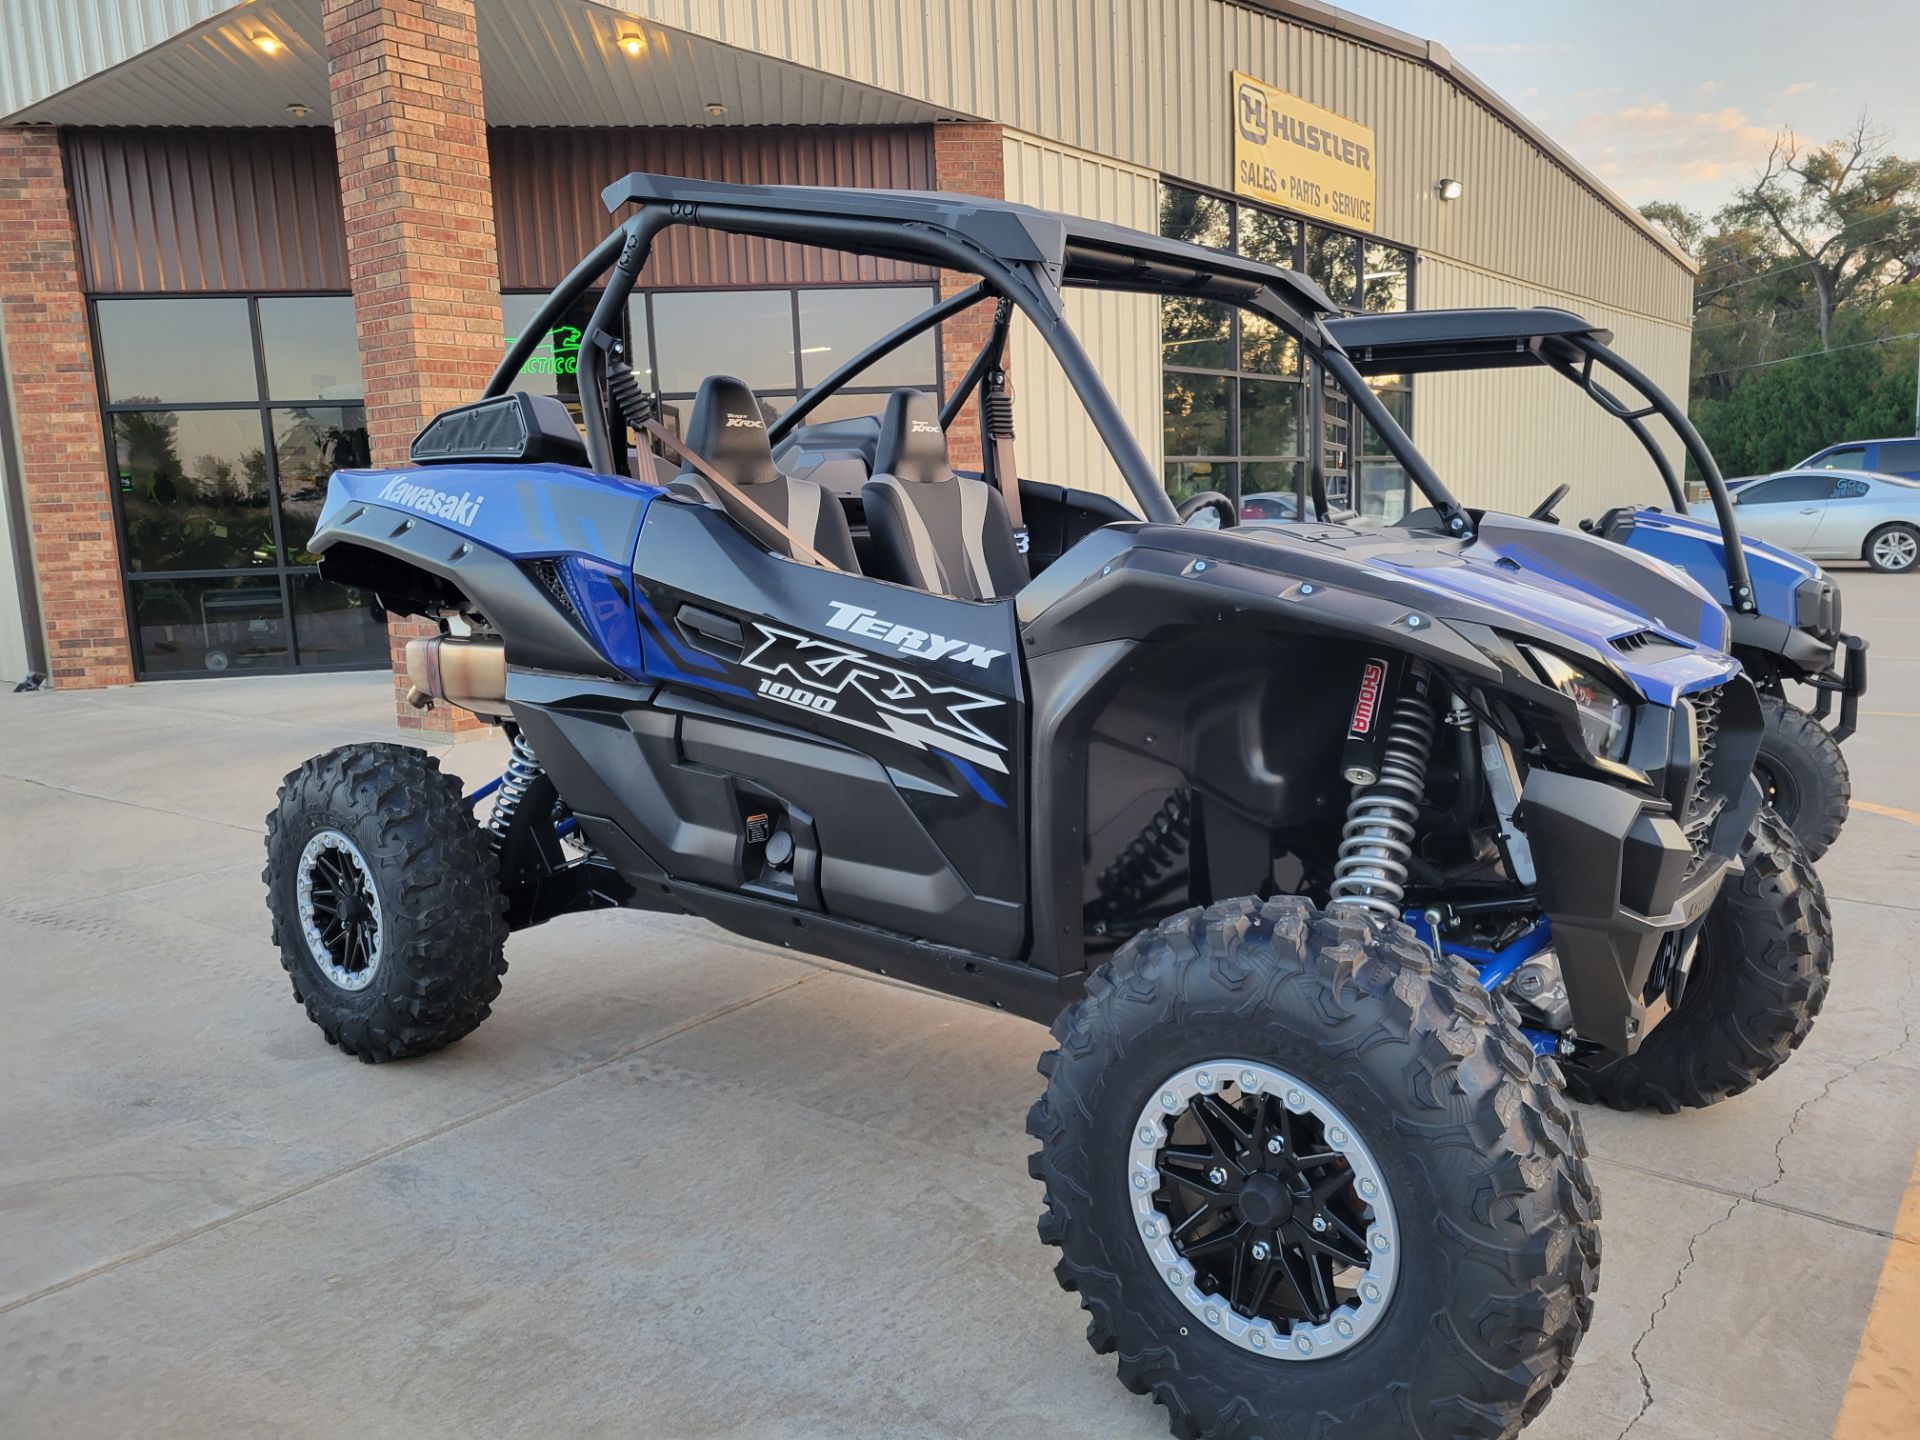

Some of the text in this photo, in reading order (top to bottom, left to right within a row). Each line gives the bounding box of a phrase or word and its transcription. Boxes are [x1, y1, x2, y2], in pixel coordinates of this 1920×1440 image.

[1271, 110, 1370, 172] HUSTLER
[1240, 159, 1371, 223] SALES PARTS SERVICE
[726, 418, 763, 428] KRX
[378, 475, 485, 528] Kawasaki
[825, 601, 1005, 669] TERYX
[740, 622, 1009, 751] KRX
[757, 678, 837, 713] 1000
[1351, 664, 1382, 733] SHOWA
